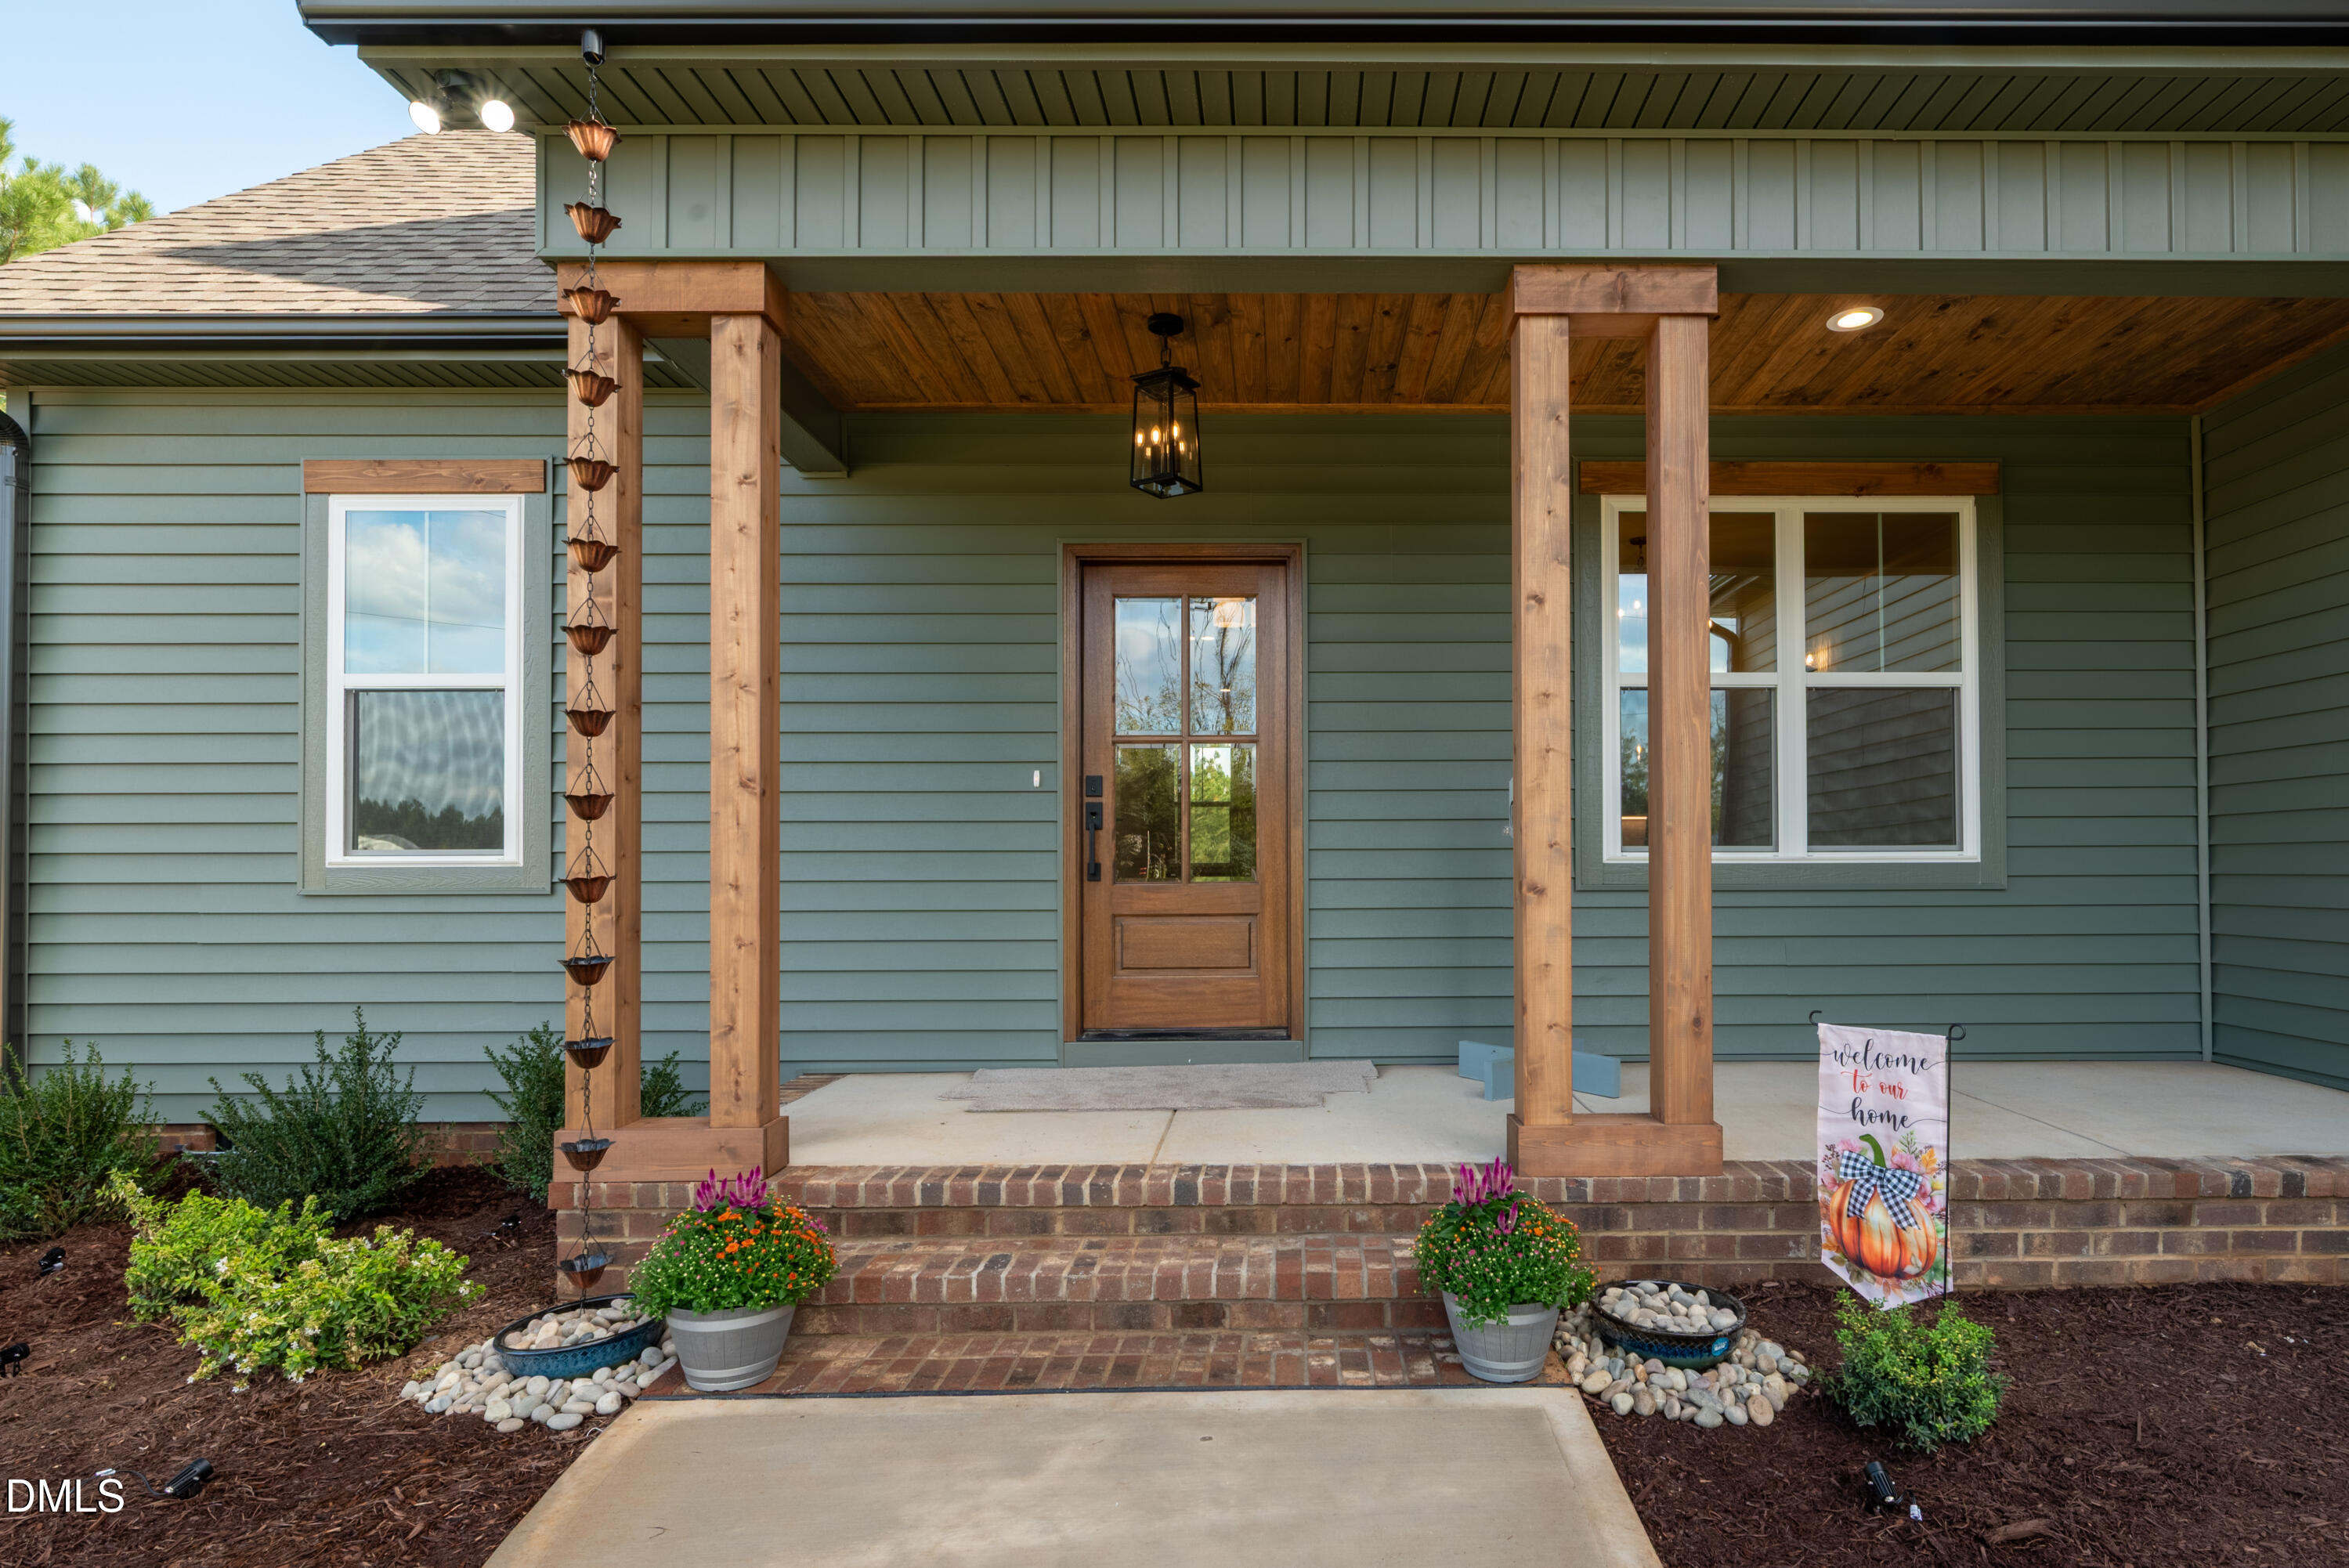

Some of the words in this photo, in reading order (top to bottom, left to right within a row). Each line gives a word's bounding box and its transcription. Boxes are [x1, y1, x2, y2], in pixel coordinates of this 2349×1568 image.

[1828, 1039, 1938, 1075] welcome
[1841, 1069, 1873, 1093] to
[1879, 1081, 1908, 1100] our
[1847, 1097, 1920, 1132] home
